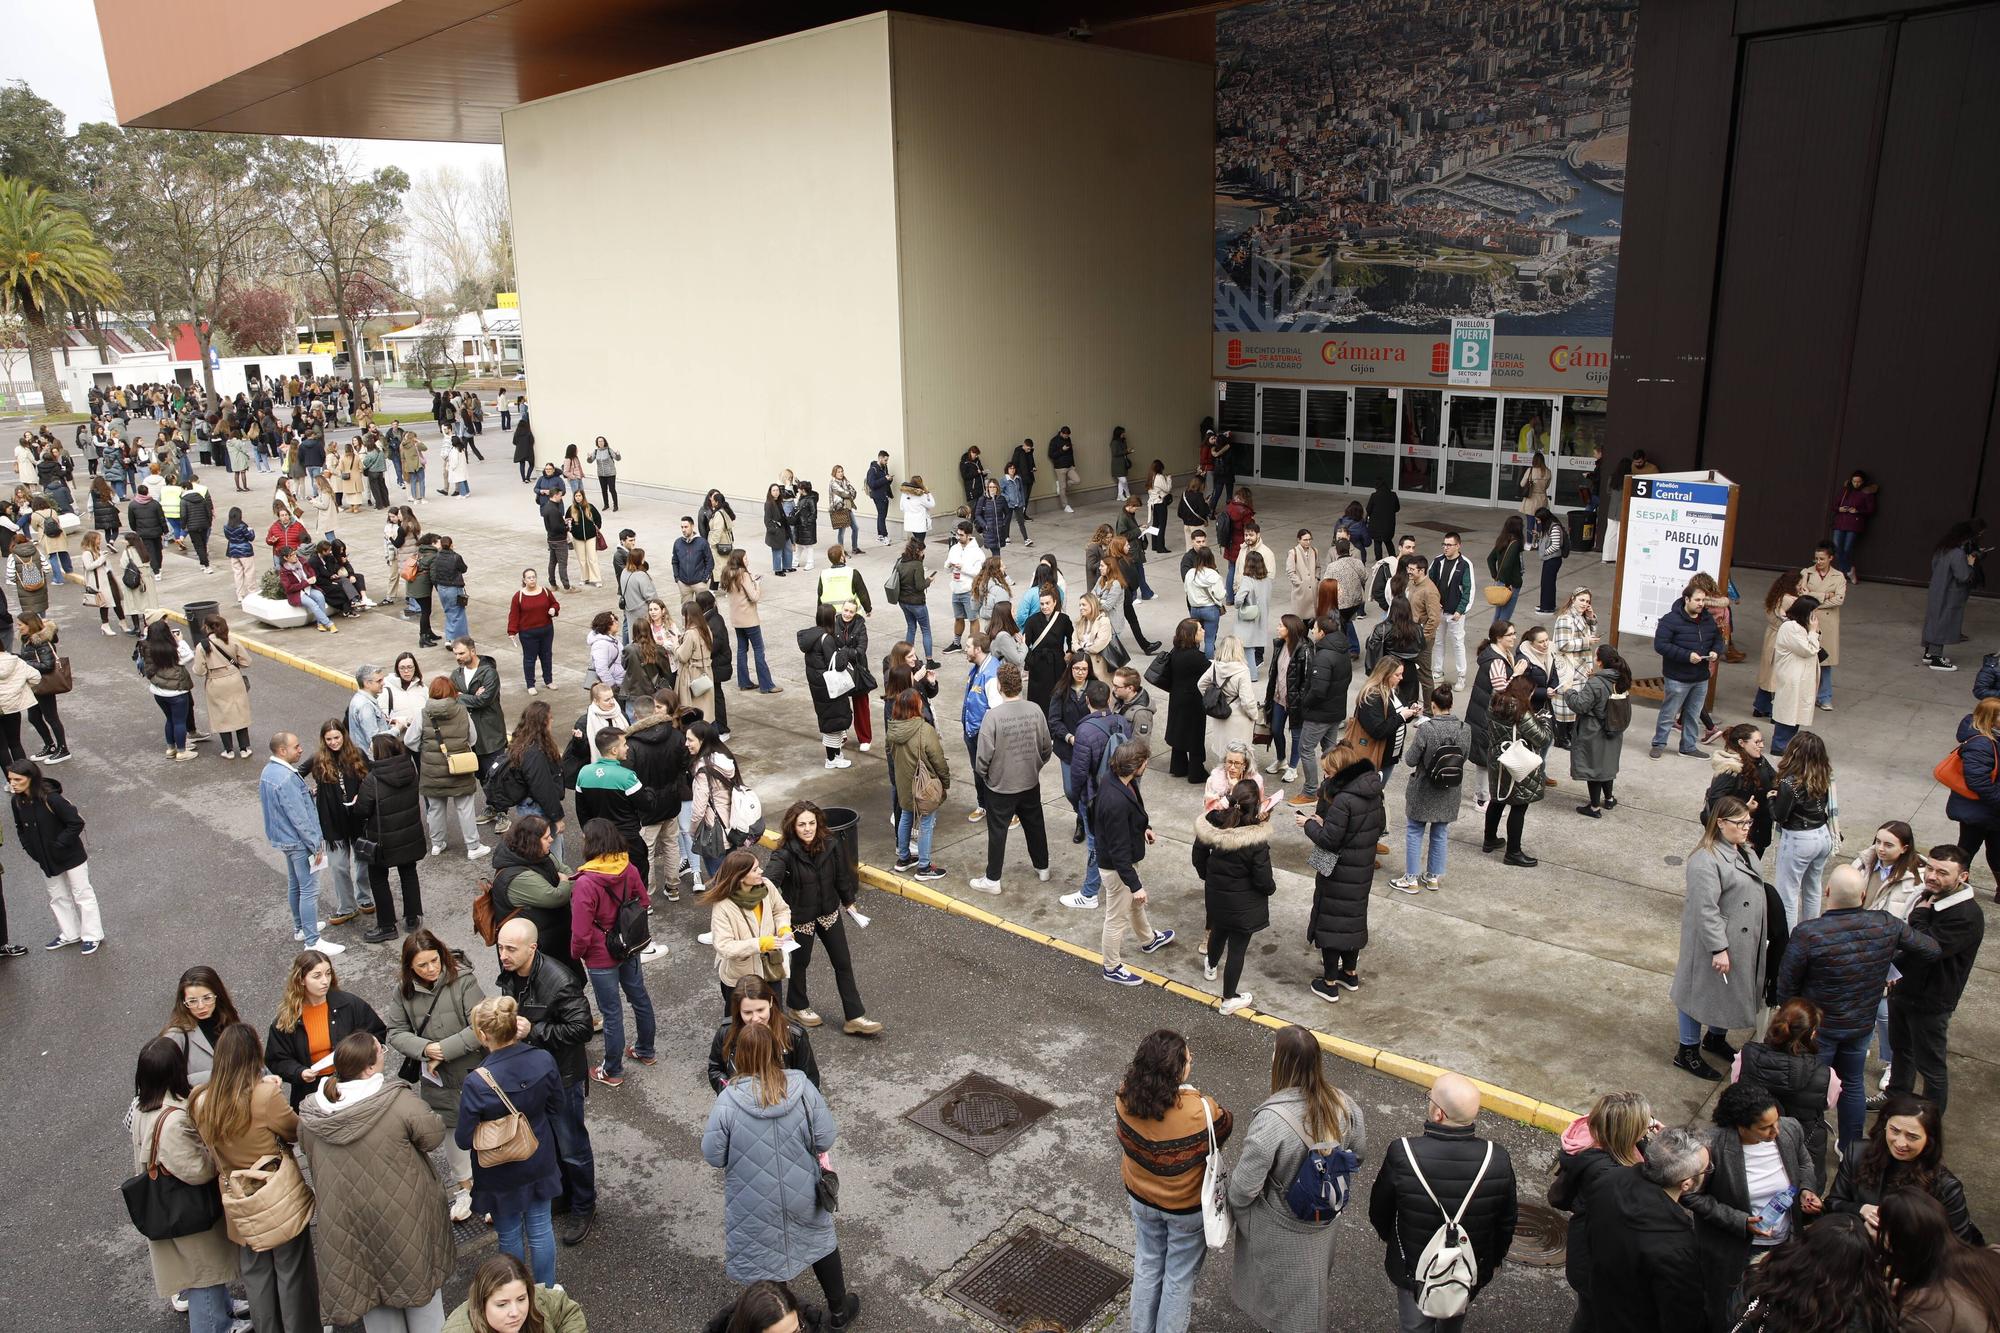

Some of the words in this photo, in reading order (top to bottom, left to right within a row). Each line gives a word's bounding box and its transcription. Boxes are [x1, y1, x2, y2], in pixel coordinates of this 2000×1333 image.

[1456, 319, 1484, 328] PABELLÓN
[1456, 329, 1488, 340] PUERTA
[1245, 346, 1276, 354] RECINTO
[1277, 346, 1302, 354] FERIAL
[1321, 340, 1406, 365] Cámara
[1461, 341, 1480, 368] B
[1269, 354, 1302, 362] ASTURIAS
[1494, 352, 1525, 361] FERIAL
[1549, 345, 1608, 373] Cám
[1258, 361, 1275, 369] LUIS
[1275, 362, 1302, 370] ADARO
[1350, 364, 1375, 375] Gijón
[1492, 360, 1525, 369] TURIAS
[1491, 368, 1524, 378] ADARO
[1585, 371, 1608, 384] Gijó
[1636, 481, 1647, 496] 5
[1655, 489, 1693, 501] Central
[1636, 510, 1669, 521] SESPA
[1665, 530, 1719, 547] PABELLÓN
[1682, 548, 1695, 568] 5
